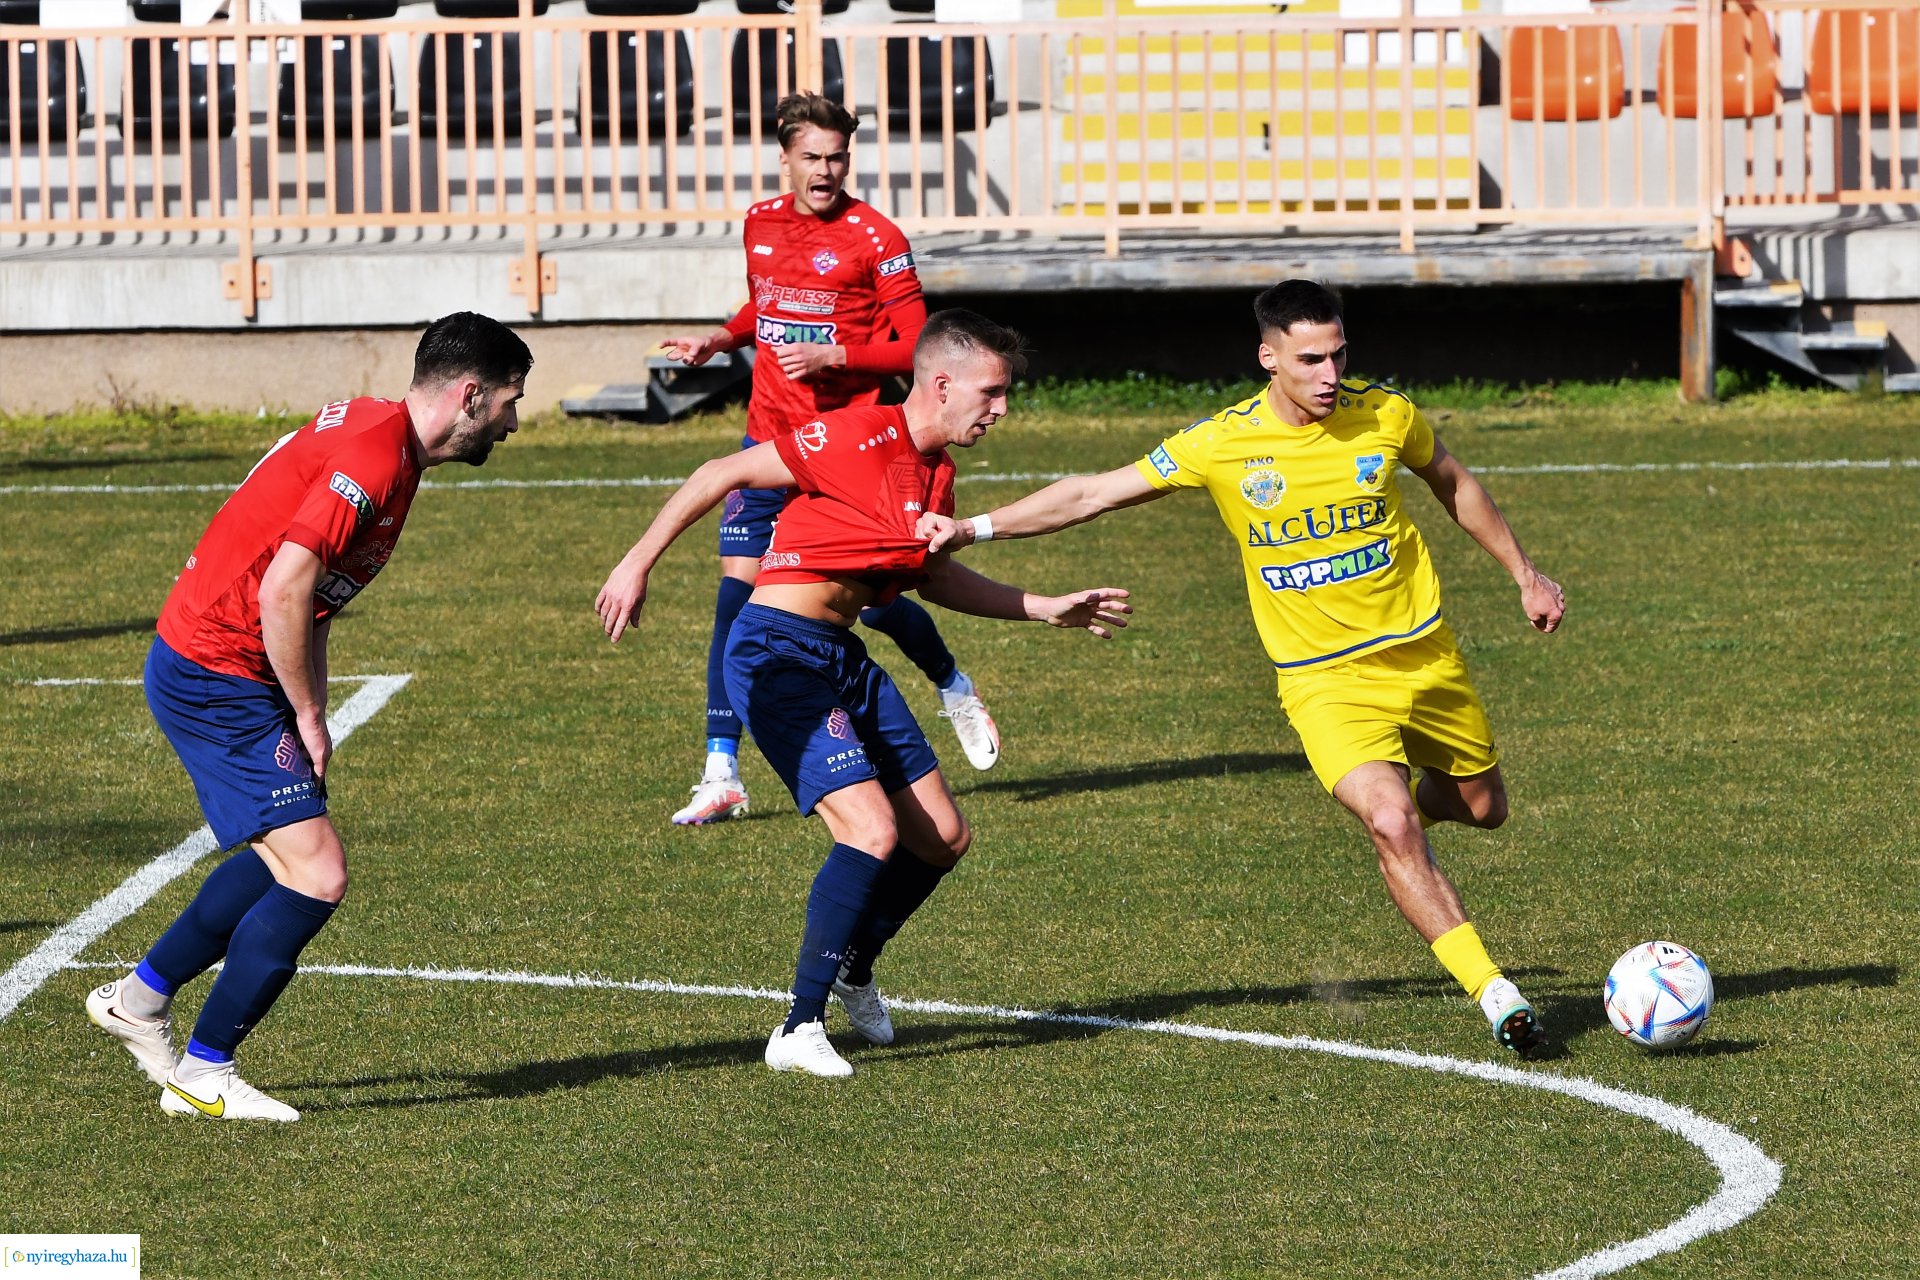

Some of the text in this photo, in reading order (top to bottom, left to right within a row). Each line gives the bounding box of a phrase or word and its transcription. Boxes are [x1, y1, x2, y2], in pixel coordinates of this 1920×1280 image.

[1244, 456, 1274, 469] JAKO
[1248, 499, 1387, 546] ALCUFER
[764, 553, 801, 569] RANS
[1264, 542, 1388, 588] TiPPMIX
[826, 748, 866, 765] PRES
